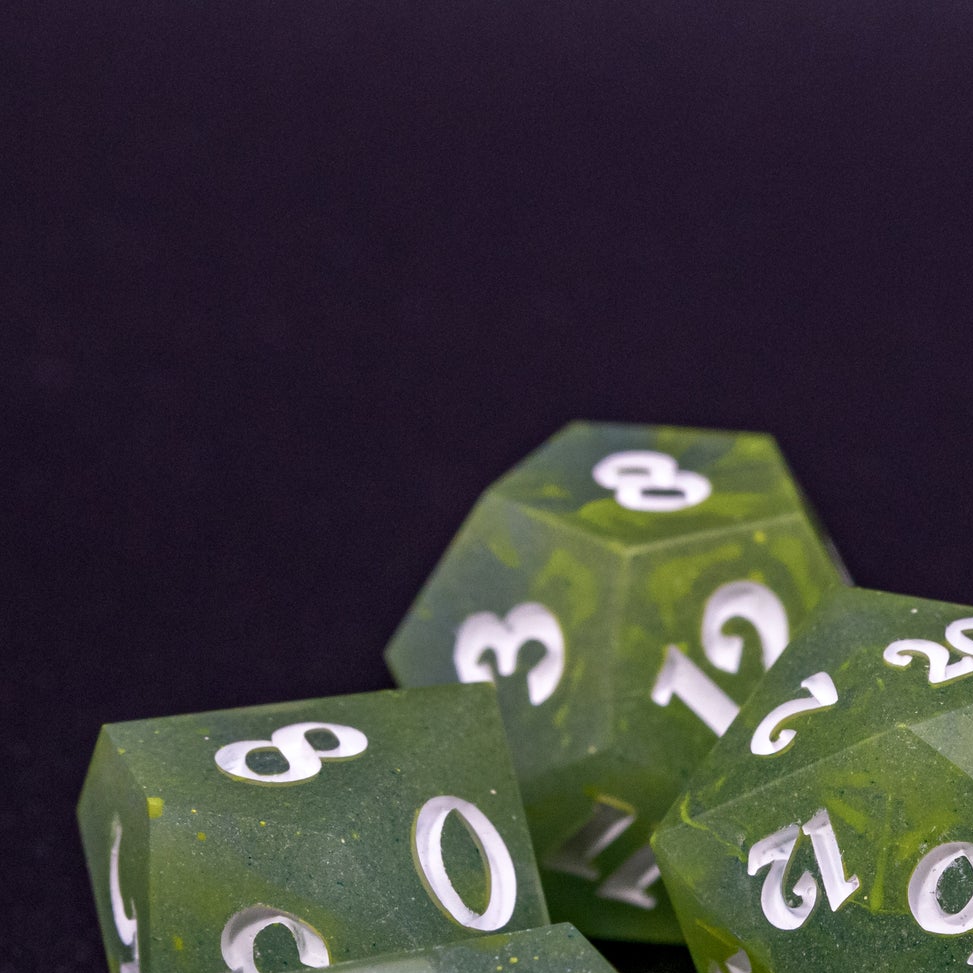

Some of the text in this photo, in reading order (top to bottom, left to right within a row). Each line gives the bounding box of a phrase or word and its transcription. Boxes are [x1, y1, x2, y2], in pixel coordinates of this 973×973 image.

[592, 450, 711, 511] 8
[452, 601, 564, 706] 3
[651, 579, 789, 738] 12
[214, 721, 369, 785] 8
[750, 671, 838, 756] 2
[411, 795, 518, 932] 0
[747, 806, 861, 931] 12
